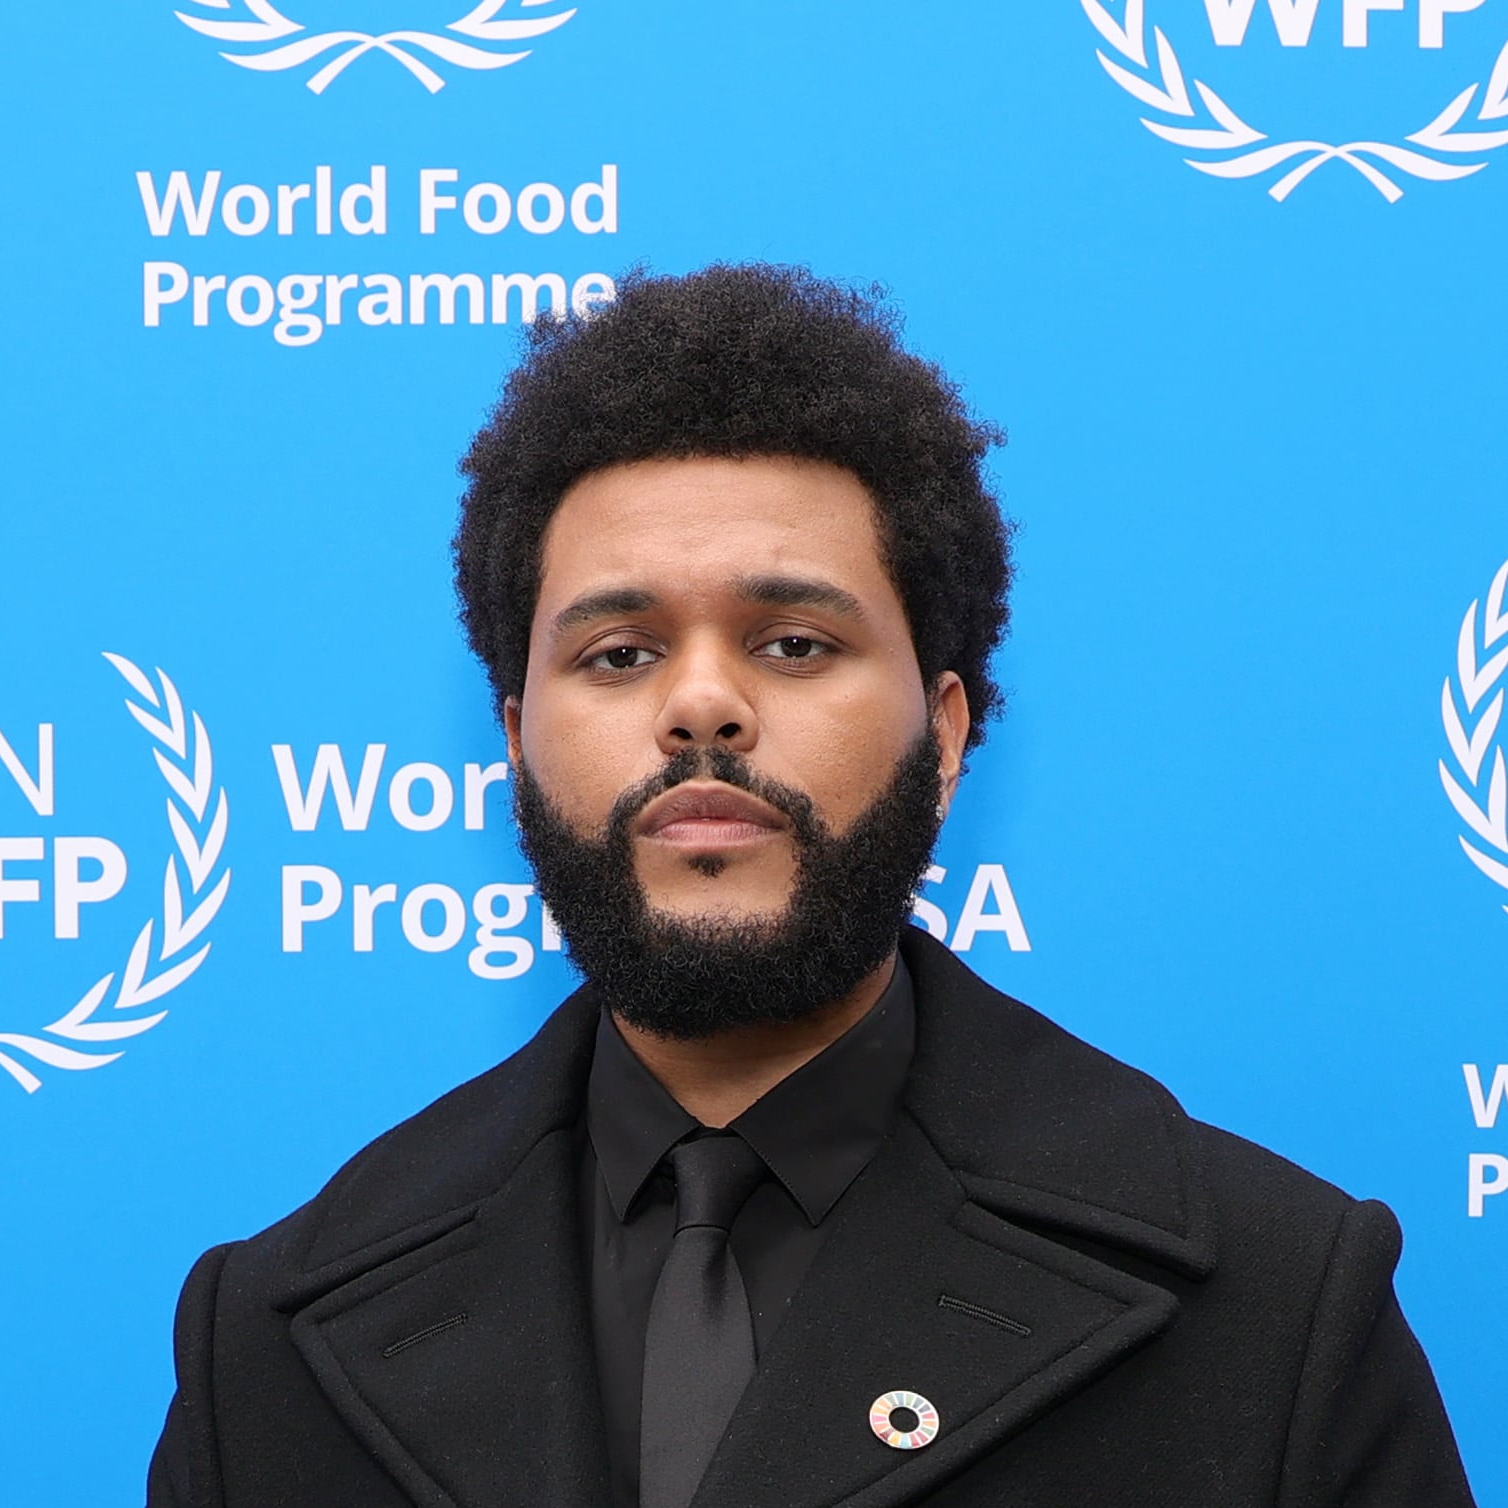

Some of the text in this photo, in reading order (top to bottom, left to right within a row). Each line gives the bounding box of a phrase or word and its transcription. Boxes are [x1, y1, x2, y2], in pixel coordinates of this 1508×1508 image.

[136, 164, 618, 237] World Food
[144, 261, 619, 347] Programme
